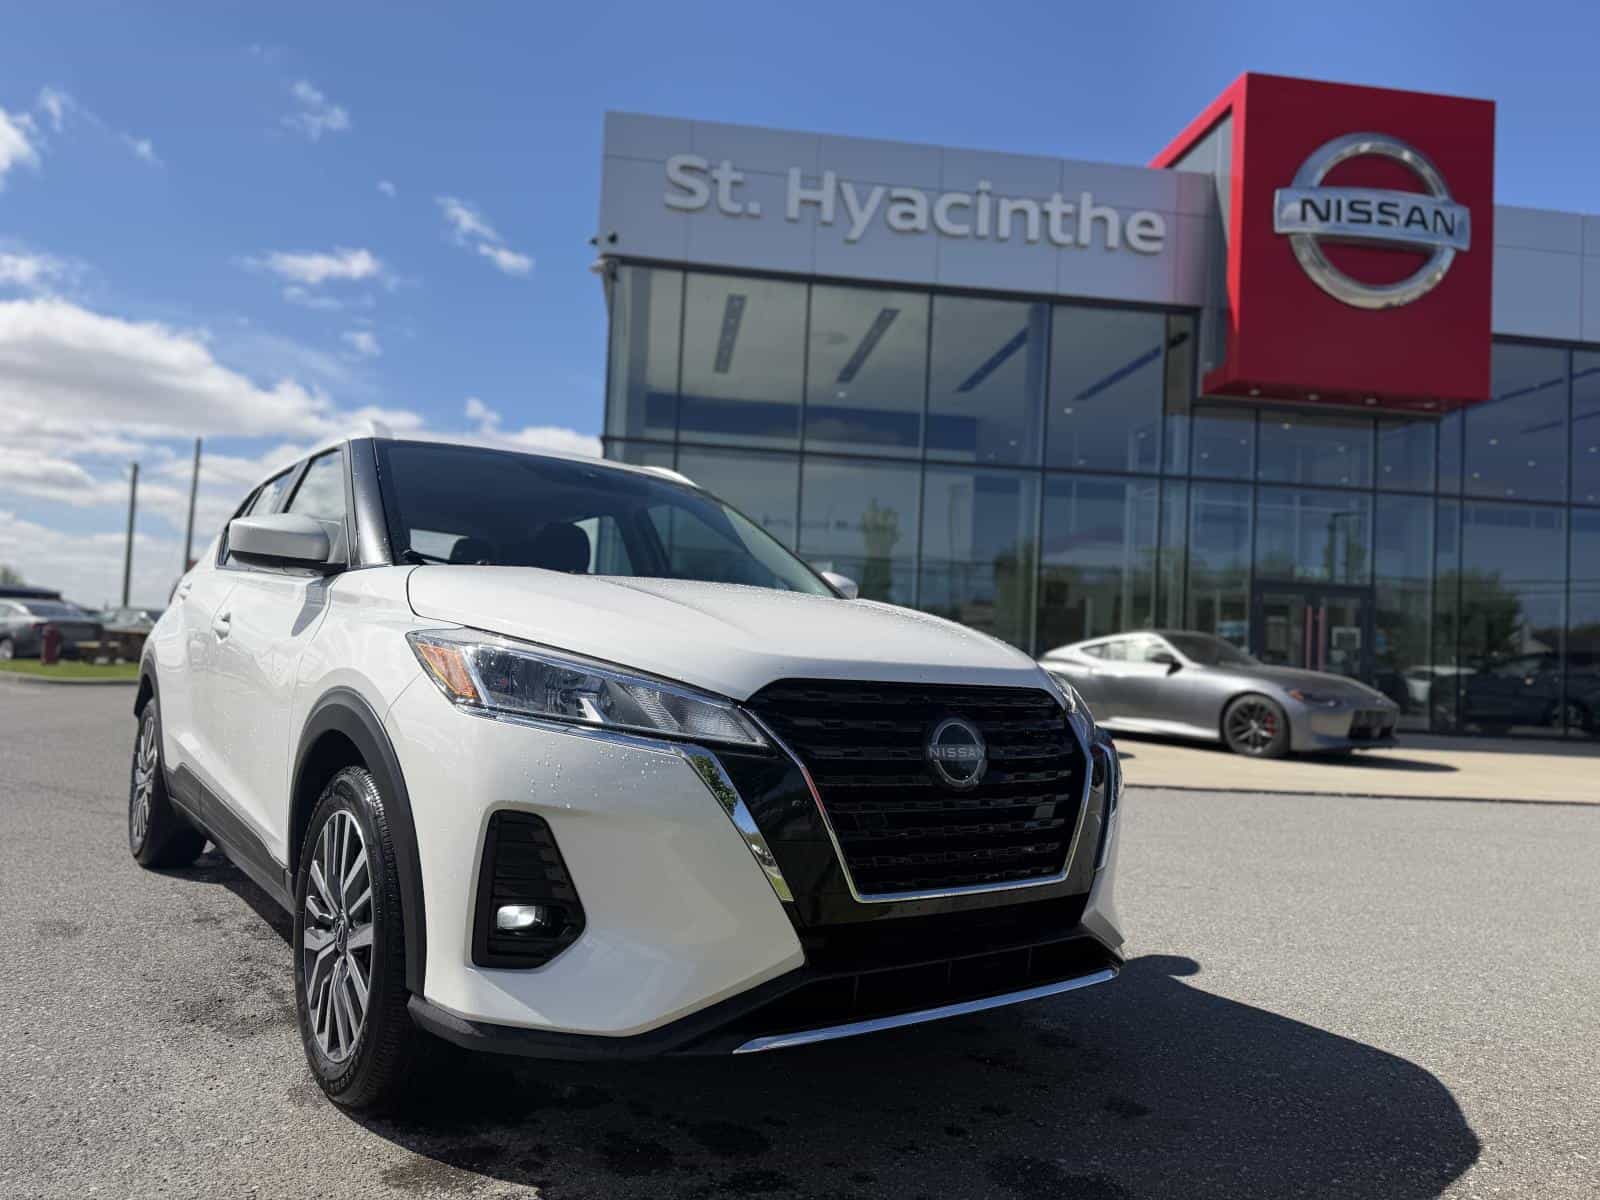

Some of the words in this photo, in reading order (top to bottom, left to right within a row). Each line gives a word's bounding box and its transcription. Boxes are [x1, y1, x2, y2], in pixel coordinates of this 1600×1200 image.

[664, 154, 762, 218] St.
[786, 167, 1167, 255] Hyacinthe
[1300, 198, 1456, 236] NISSAN
[929, 746, 984, 759] NISSAN
